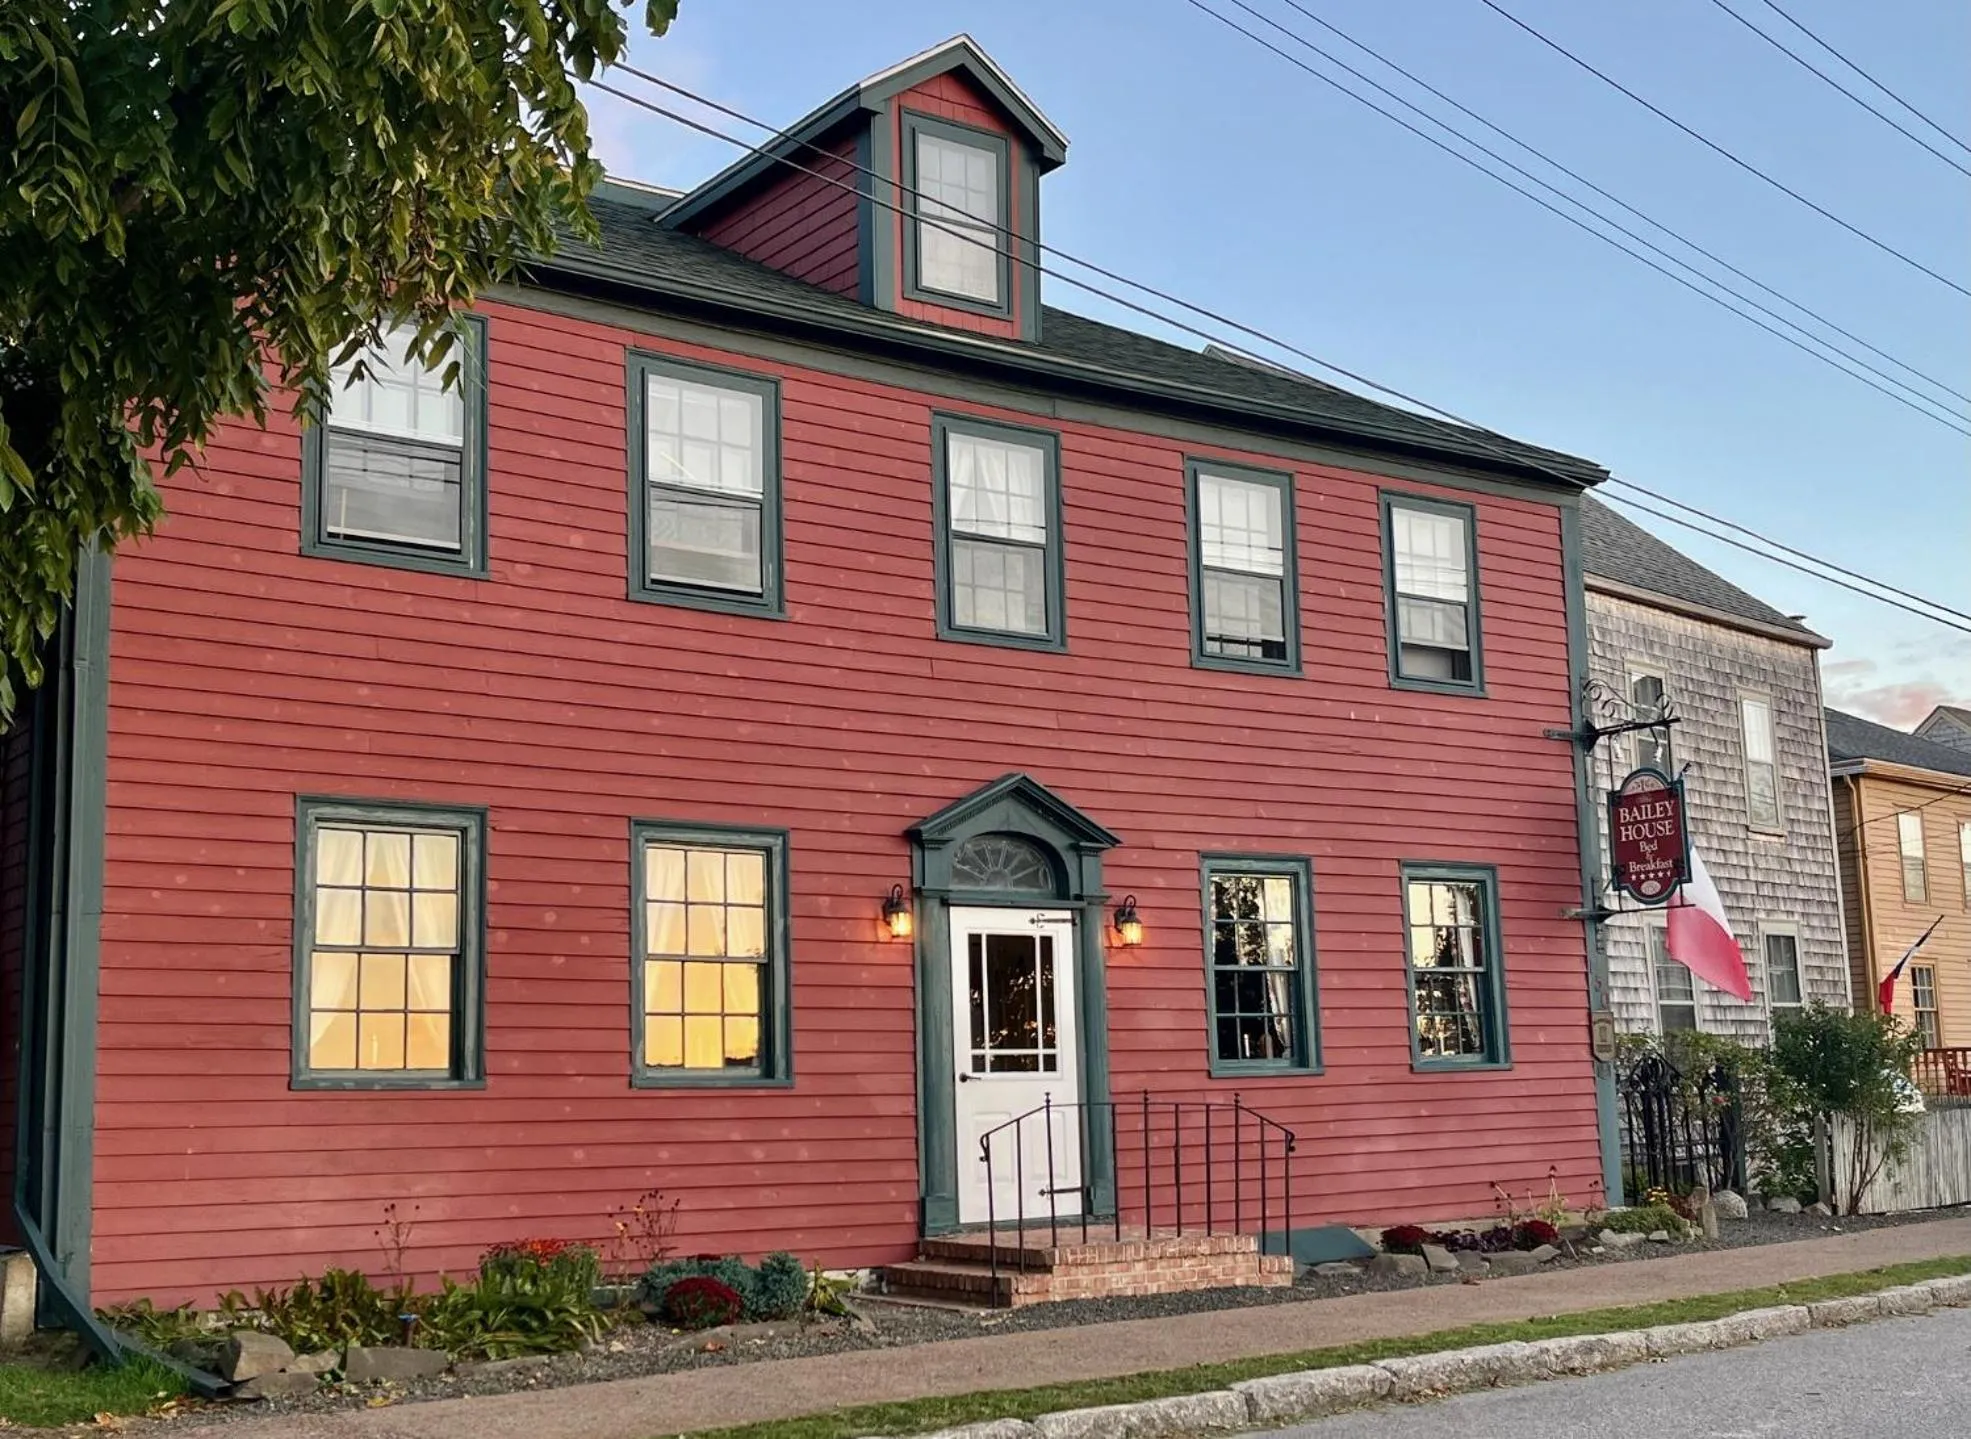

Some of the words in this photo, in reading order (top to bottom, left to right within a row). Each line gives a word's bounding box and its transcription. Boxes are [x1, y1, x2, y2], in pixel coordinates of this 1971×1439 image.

[1619, 800, 1675, 823] BAILEY
[1620, 820, 1675, 841] HOUSE
[1639, 840, 1658, 853] Bed
[1629, 859, 1673, 873] Breakfast
